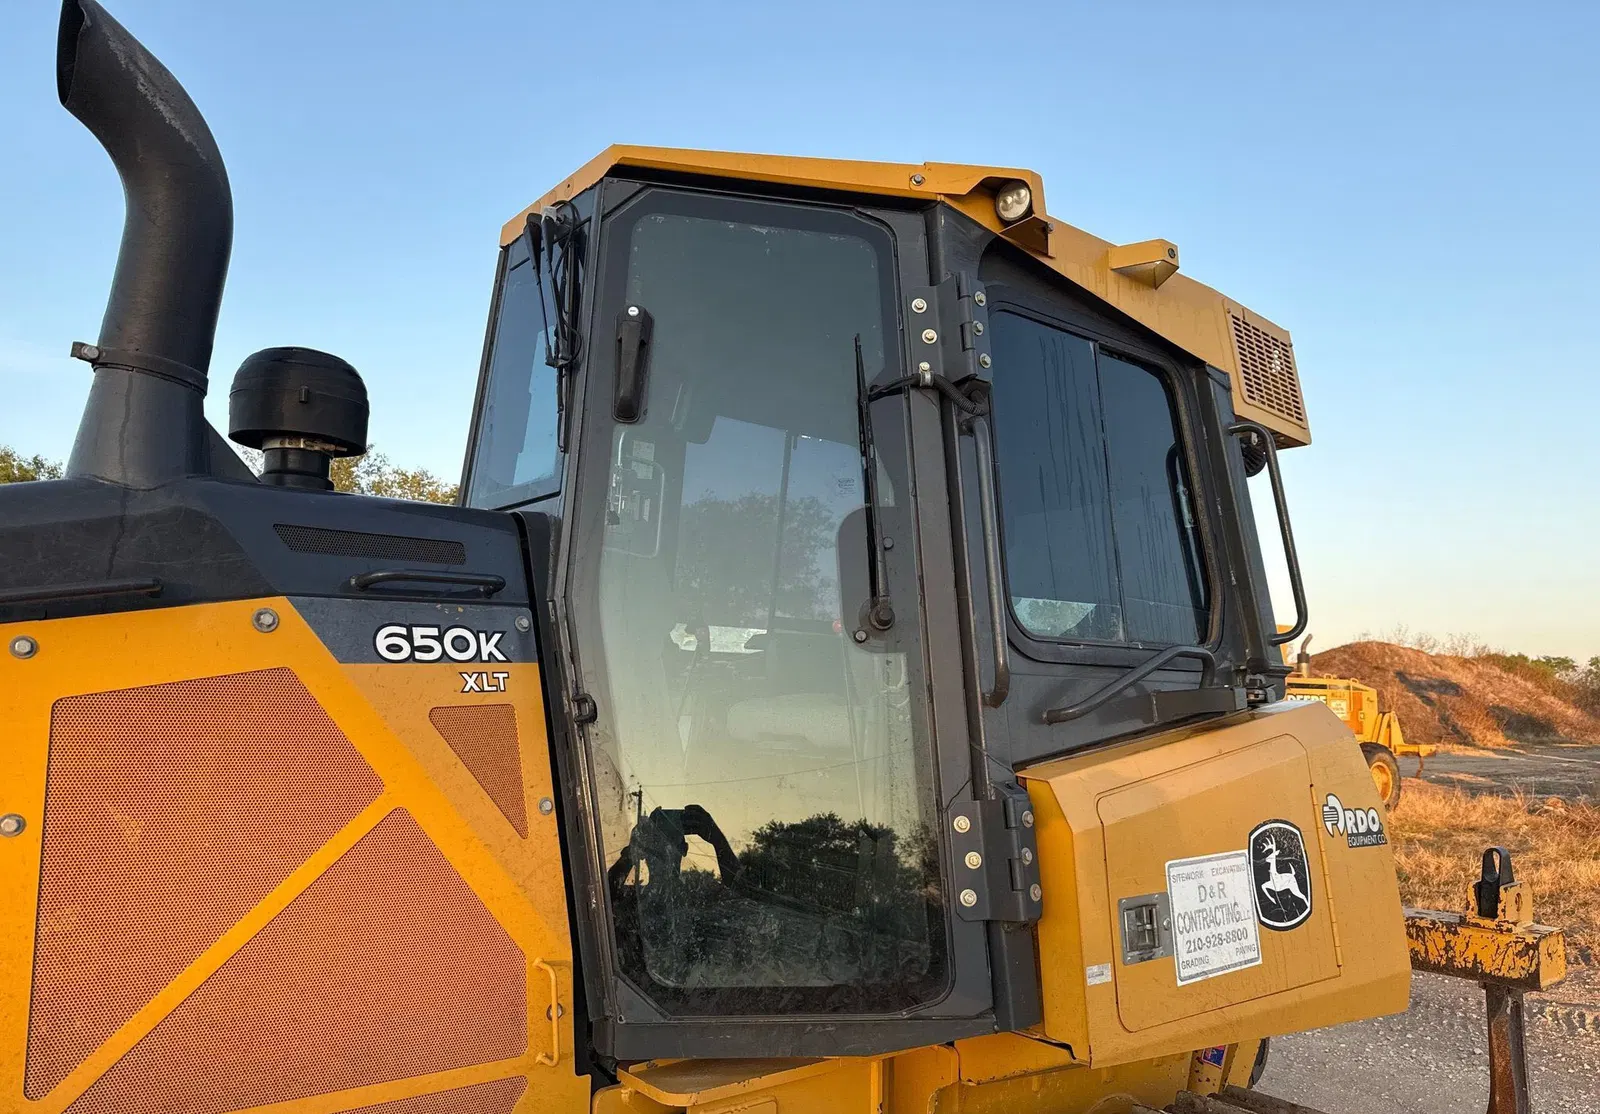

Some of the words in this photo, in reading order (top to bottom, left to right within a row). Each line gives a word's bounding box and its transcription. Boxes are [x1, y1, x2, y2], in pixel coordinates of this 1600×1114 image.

[374, 623, 512, 663] 650K
[459, 671, 510, 693] XLT
[1347, 834, 1377, 847] EQUIPMENT
[1171, 870, 1204, 884] SITEWORK
[1211, 863, 1246, 877] EXCAVATING
[1176, 901, 1240, 935] CONTRACTING
[1185, 927, 1248, 954] 210-928-8800
[1235, 944, 1256, 956] PAVING
[1181, 955, 1209, 970] GRADING
